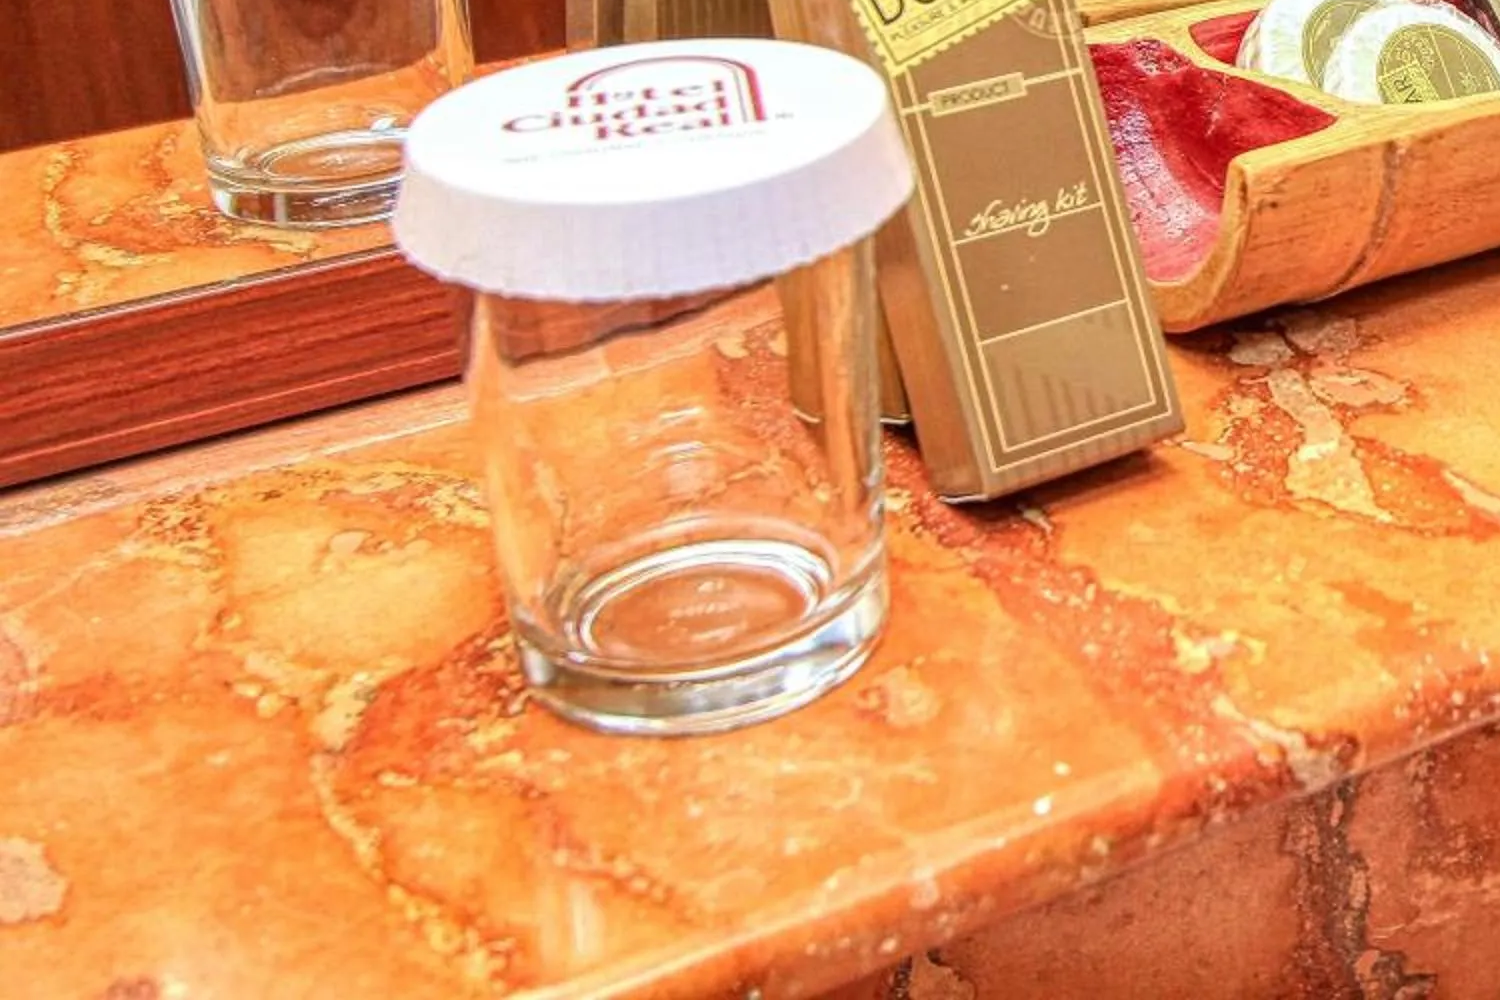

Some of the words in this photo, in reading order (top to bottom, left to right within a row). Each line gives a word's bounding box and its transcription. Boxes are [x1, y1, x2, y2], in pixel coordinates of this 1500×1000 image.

[567, 79, 727, 108] Hotel
[940, 80, 1010, 107] PRODUCT
[501, 96, 728, 134] Ciudad
[596, 113, 731, 141] Real
[1055, 181, 1089, 212] kit
